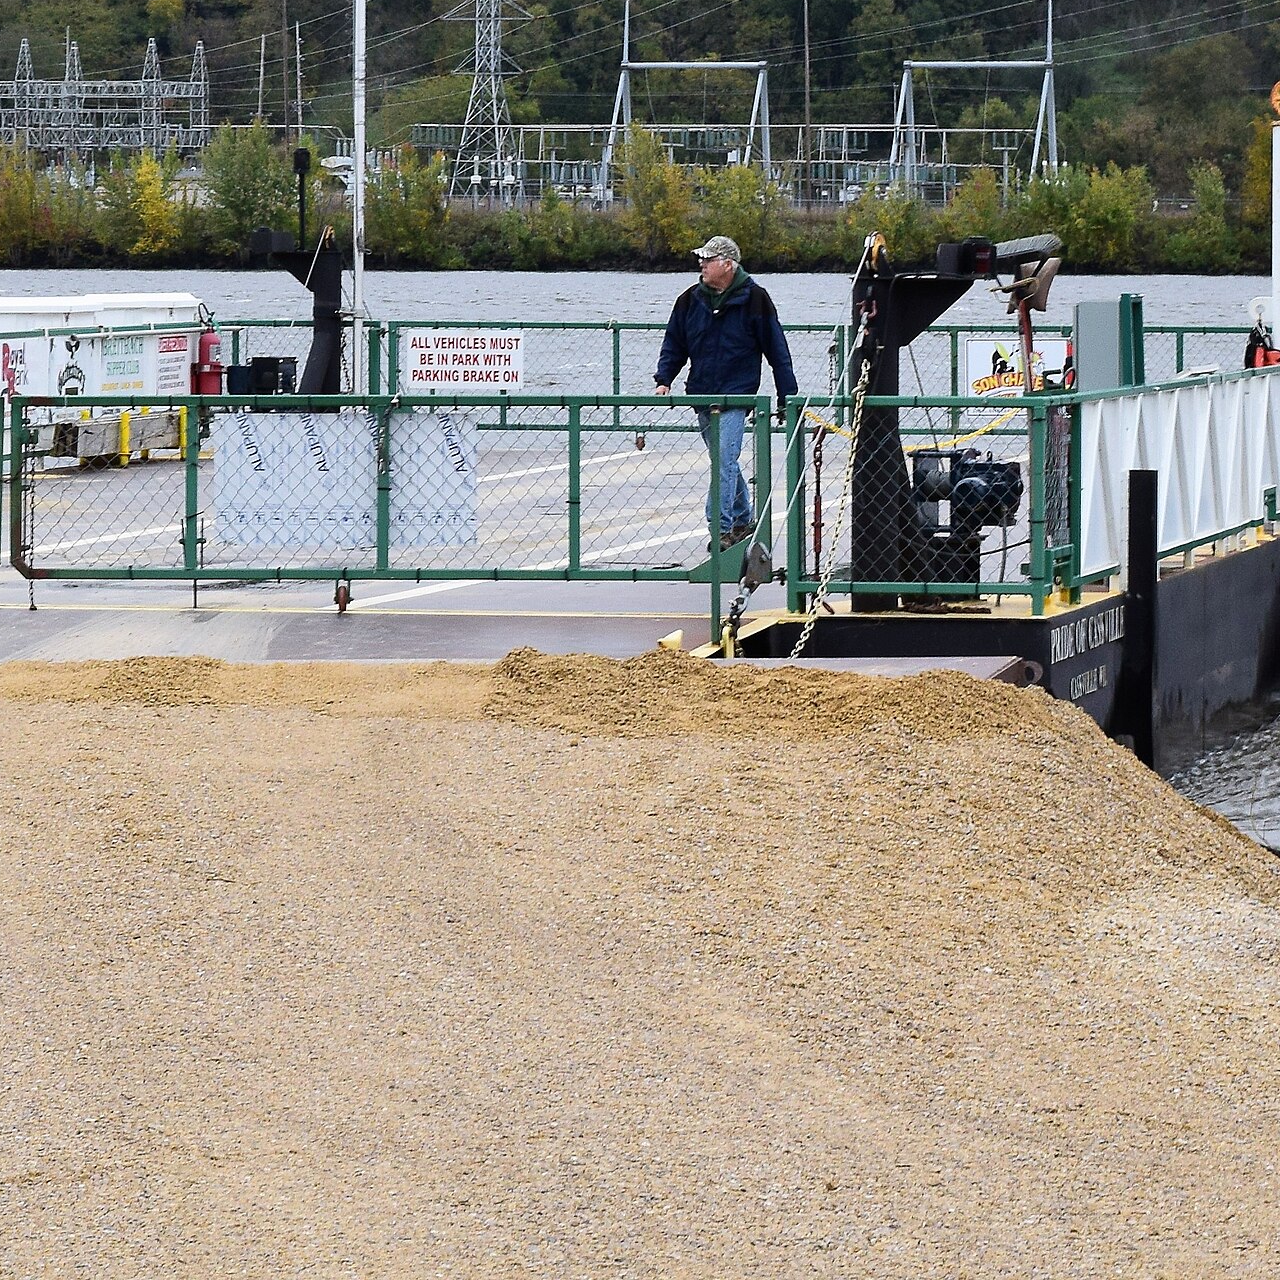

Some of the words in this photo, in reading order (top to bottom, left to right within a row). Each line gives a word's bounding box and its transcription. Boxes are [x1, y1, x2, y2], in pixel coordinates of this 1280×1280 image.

[411, 337, 430, 349] ALL
[434, 337, 486, 349] VEHICLES
[490, 338, 520, 350] MUST
[420, 353, 433, 365] BE
[437, 354, 448, 365] IN
[452, 354, 479, 366] PARK
[483, 354, 511, 366] WITH
[412, 370, 459, 382] PARKING
[463, 370, 499, 383] BRAKE
[503, 371, 518, 382] ON
[972, 375, 999, 395] SON
[1001, 372, 1044, 391] CHAE
[1050, 622, 1075, 665] PRIDE
[1075, 617, 1087, 654] OF
